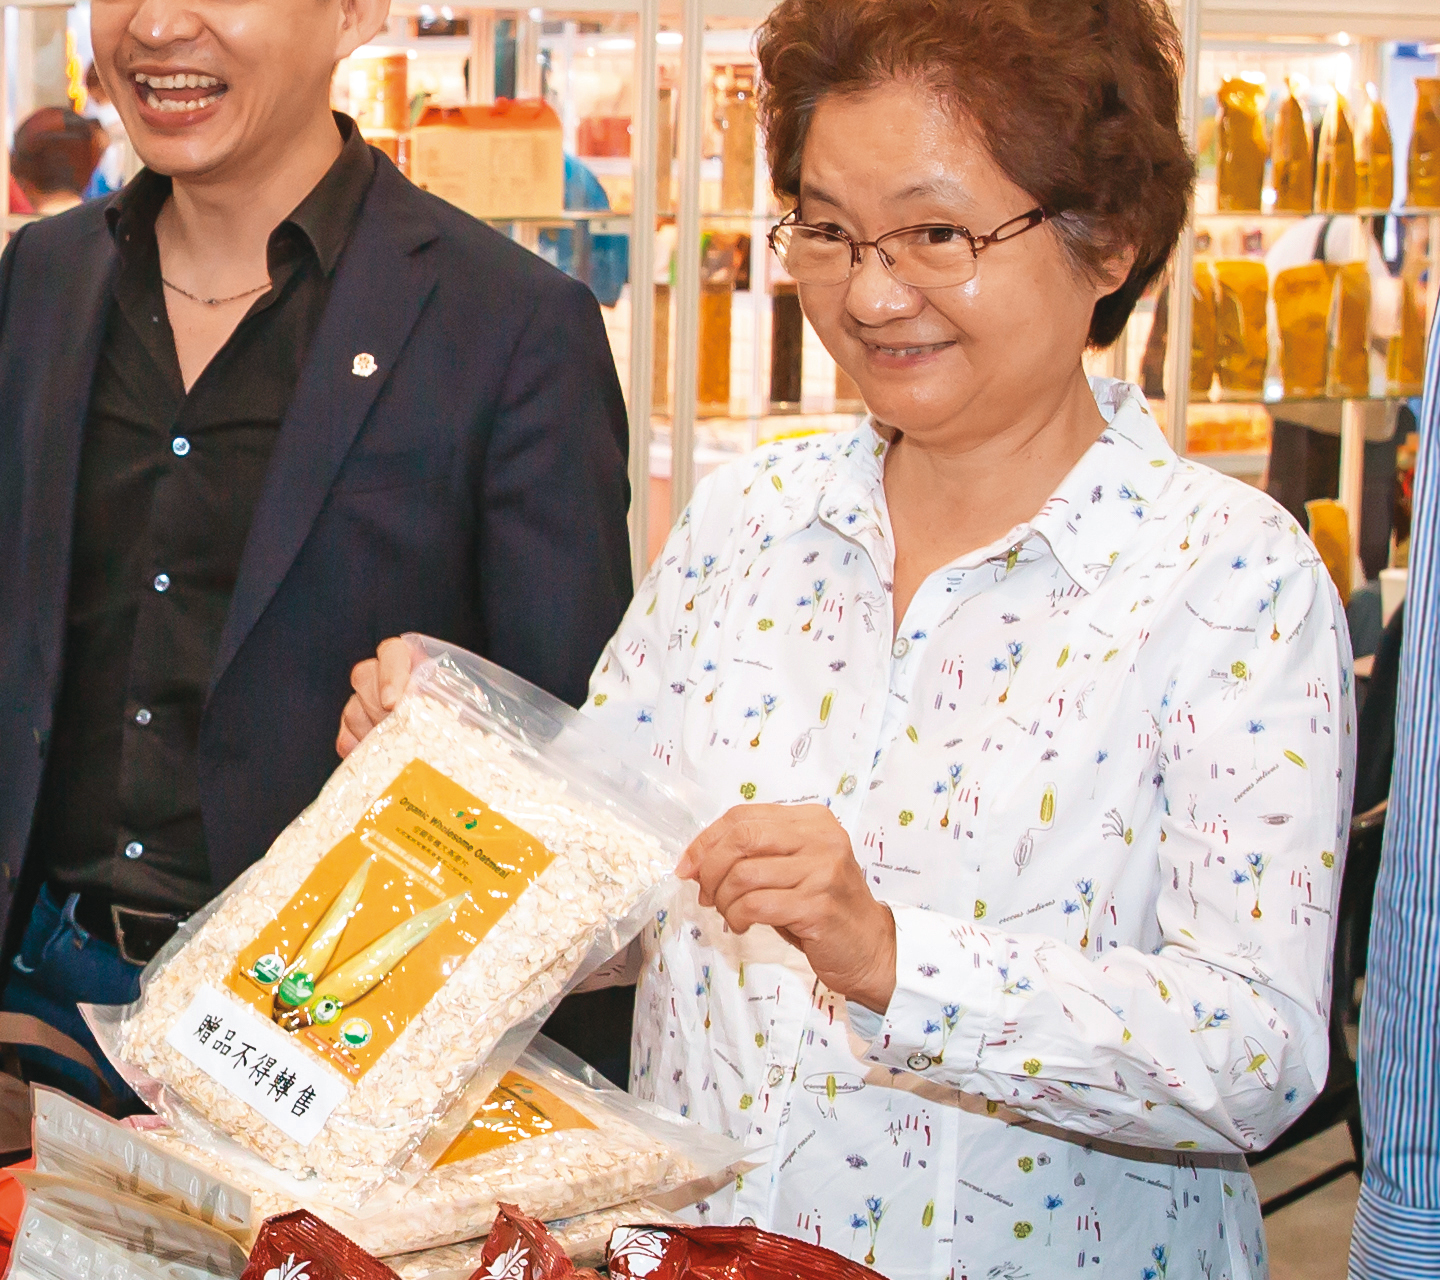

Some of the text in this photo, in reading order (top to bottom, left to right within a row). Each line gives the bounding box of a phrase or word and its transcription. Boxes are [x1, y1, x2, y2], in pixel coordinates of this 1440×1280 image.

[399, 796, 430, 821] Organic
[430, 816, 474, 852] Wholesome
[474, 848, 511, 880] Oatmeal
[193, 1013, 317, 1118] 贈品不得轉售
